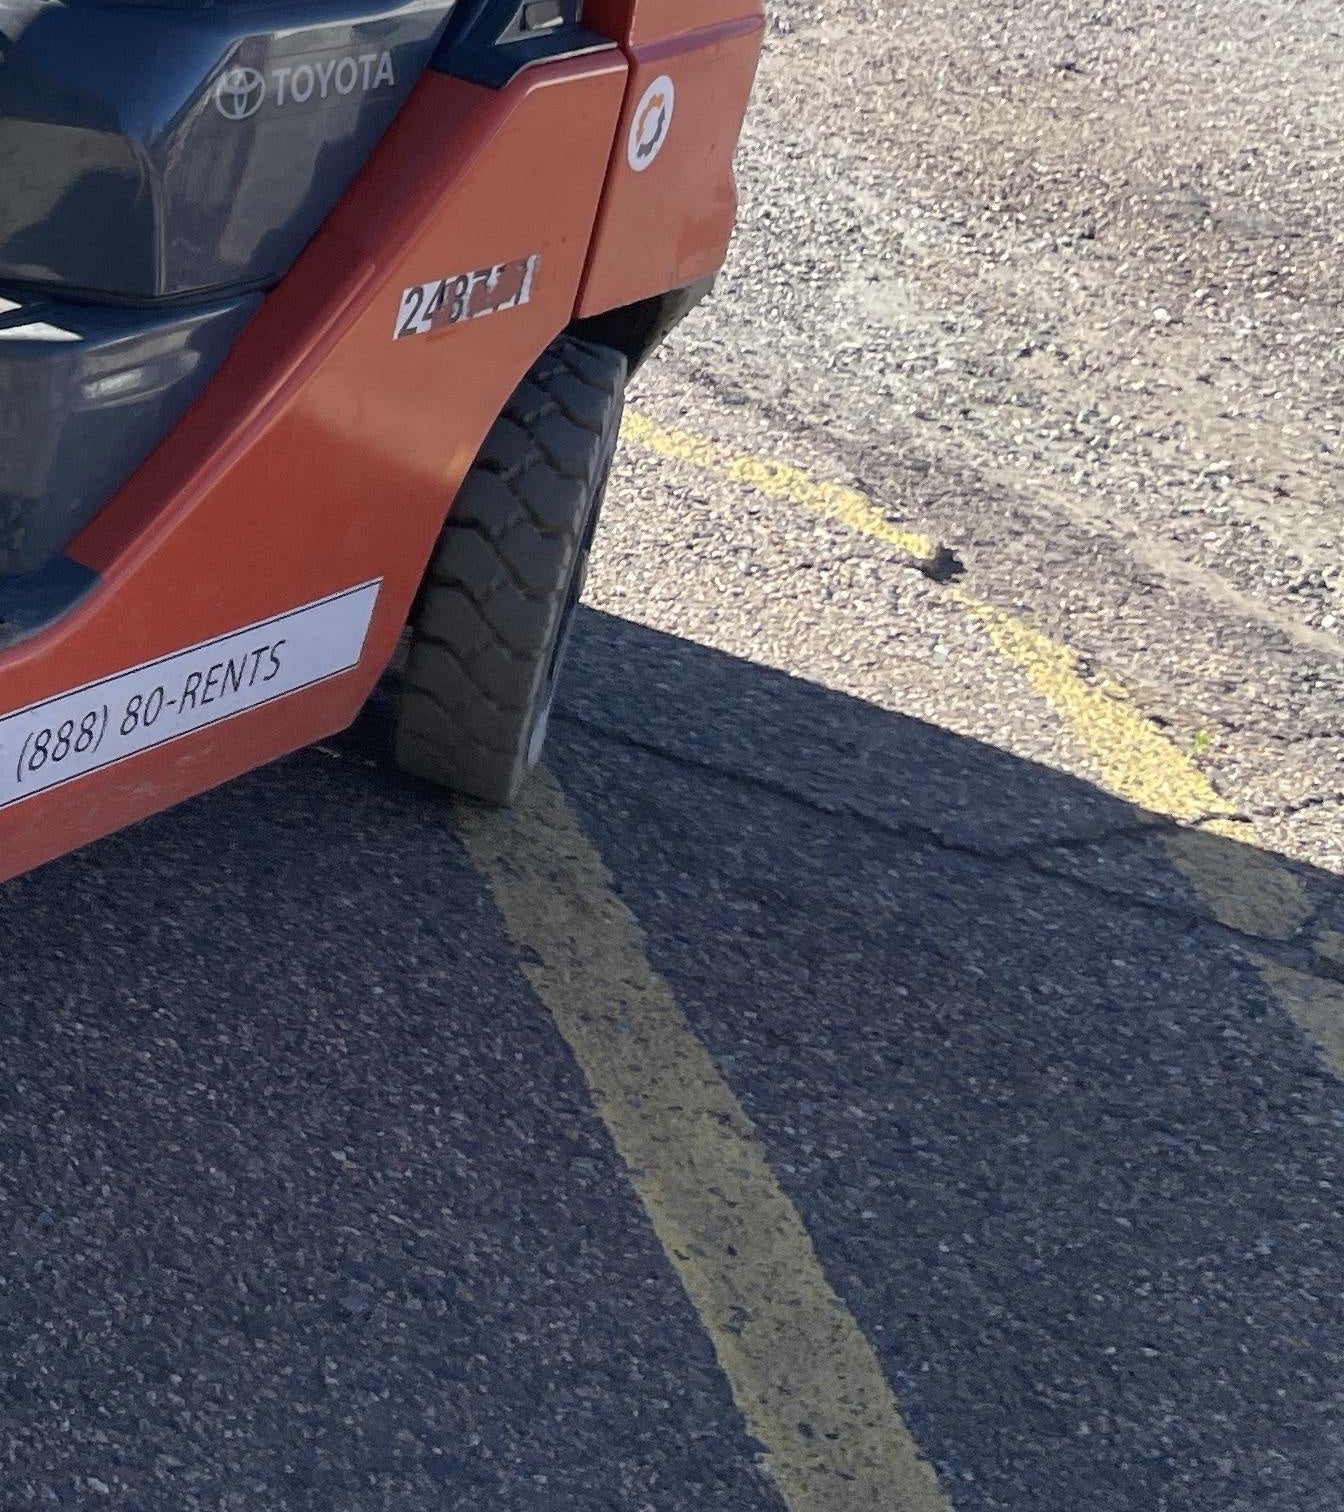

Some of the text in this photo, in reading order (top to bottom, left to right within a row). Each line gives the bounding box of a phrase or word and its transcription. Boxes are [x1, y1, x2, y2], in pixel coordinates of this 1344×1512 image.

[272, 51, 395, 106] TOYOTA
[16, 640, 287, 782] (888) 80-RENTS
